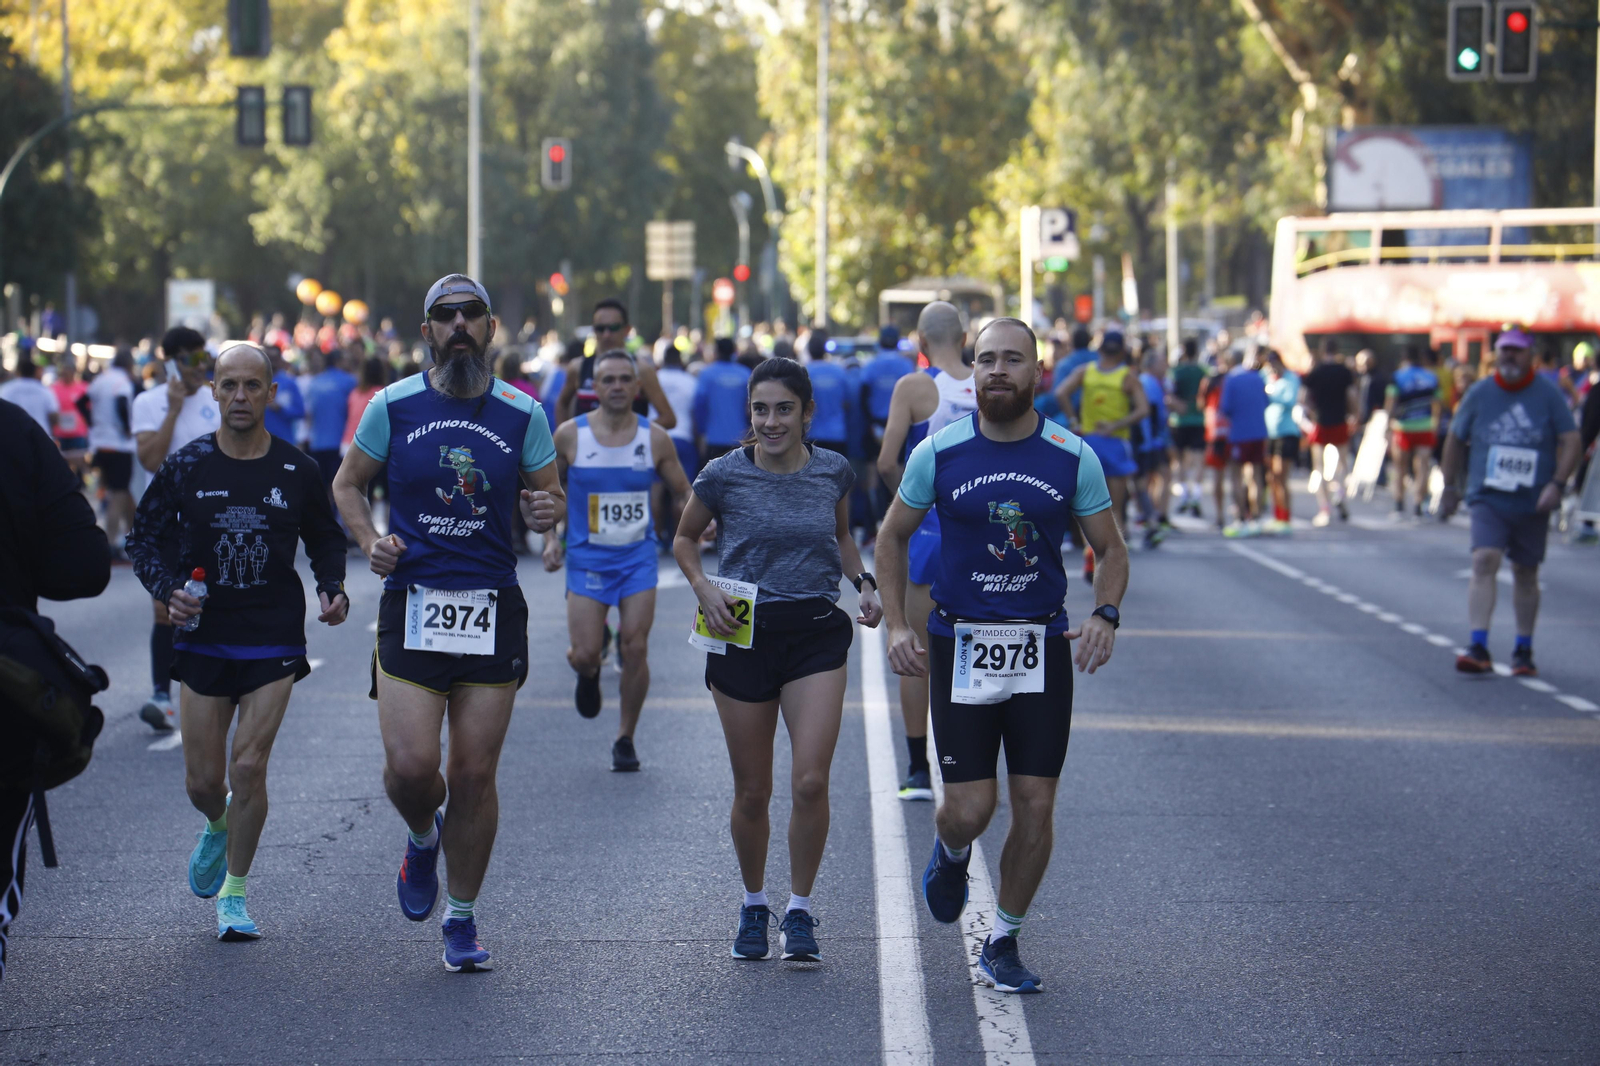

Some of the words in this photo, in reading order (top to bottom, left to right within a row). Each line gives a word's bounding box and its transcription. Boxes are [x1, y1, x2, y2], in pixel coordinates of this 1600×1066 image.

[1041, 208, 1069, 246] P
[407, 419, 513, 454] DELPINORUNNERS
[952, 472, 1064, 502] DELPINORUNNERS
[263, 496, 288, 507] CABRA
[601, 503, 644, 521] 1935
[418, 513, 456, 526] SOMOS
[457, 519, 486, 530] UNOS
[428, 525, 473, 537] MATAOS
[971, 571, 1010, 583] SOMOS
[1011, 571, 1040, 583] UNOS
[435, 589, 468, 599] IMDECO
[982, 582, 1027, 593] MATAOS
[411, 611, 419, 635] CAJÓN
[423, 602, 491, 633] 2974
[982, 629, 1017, 637] IMDECO
[960, 649, 968, 675] CAJÓN
[972, 642, 1039, 671] 2978
